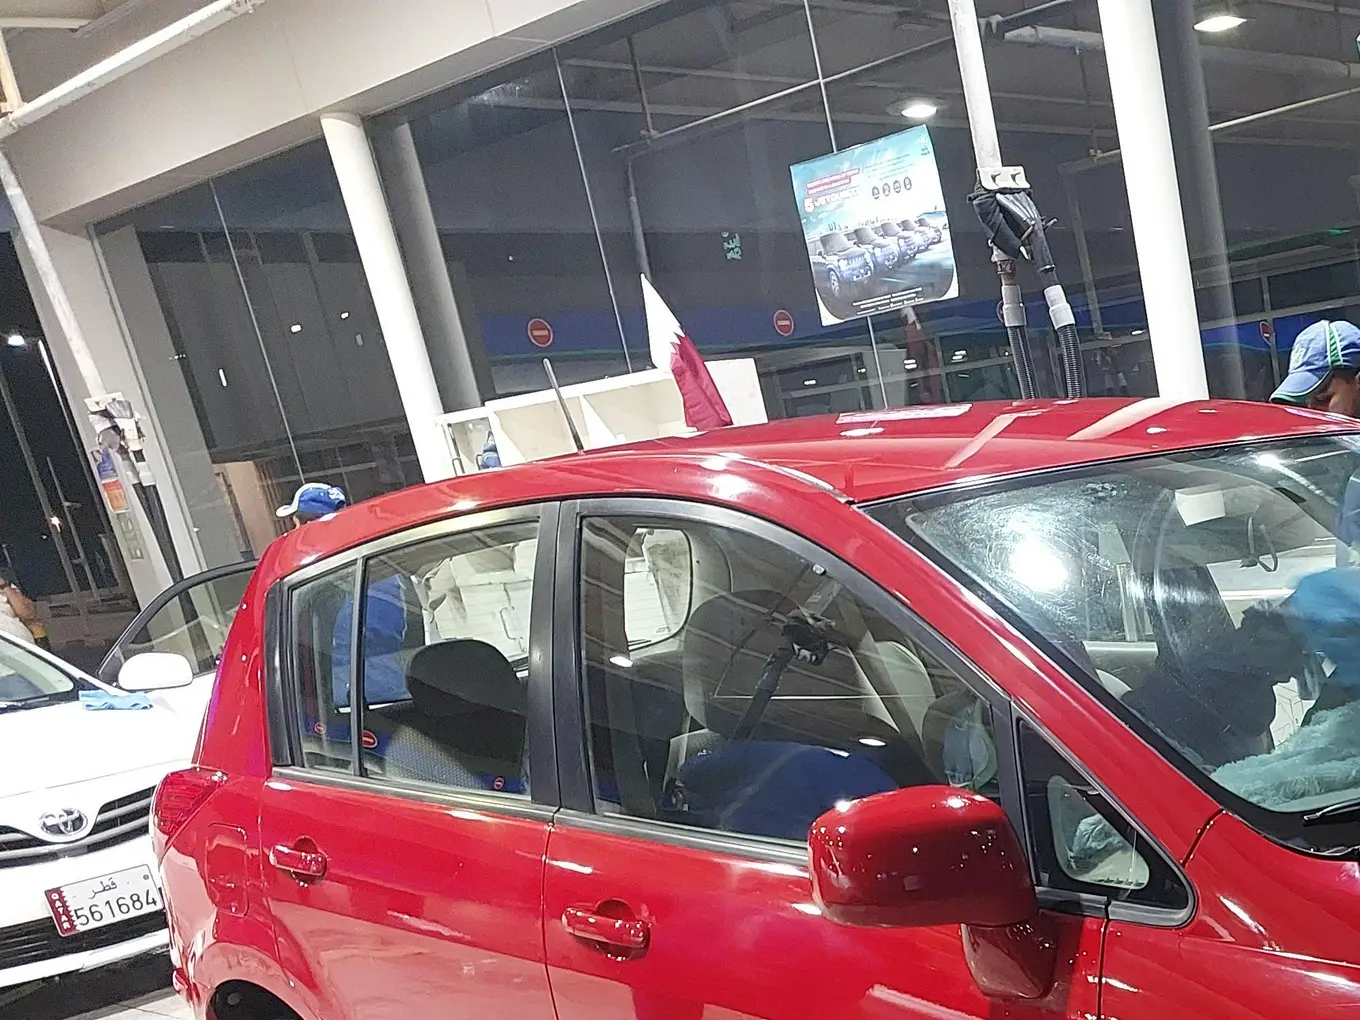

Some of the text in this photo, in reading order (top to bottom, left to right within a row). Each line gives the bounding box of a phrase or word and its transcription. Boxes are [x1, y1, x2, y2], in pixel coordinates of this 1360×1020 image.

[73, 888, 157, 926] 561684
[88, 877, 118, 900] قطر
[51, 891, 70, 930] QATAR
